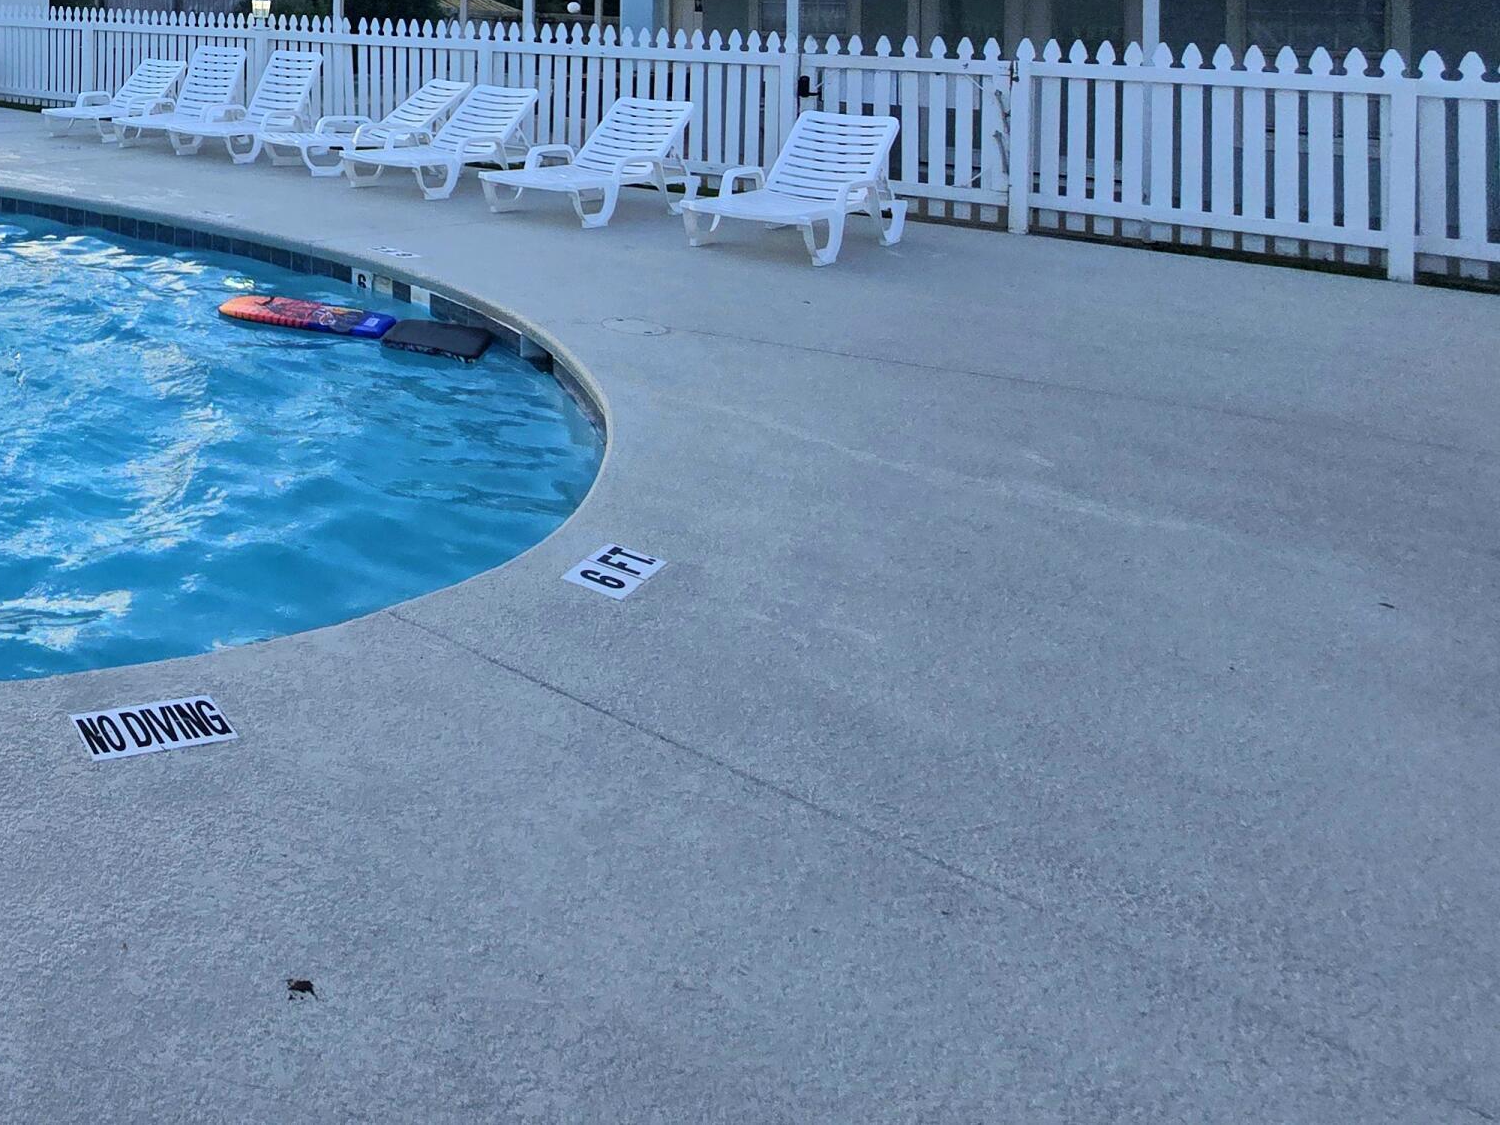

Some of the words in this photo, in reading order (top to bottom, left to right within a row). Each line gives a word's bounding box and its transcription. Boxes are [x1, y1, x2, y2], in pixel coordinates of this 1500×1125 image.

[580, 570, 626, 589] 6
[75, 715, 127, 755] NO
[118, 700, 232, 748] DIVING
